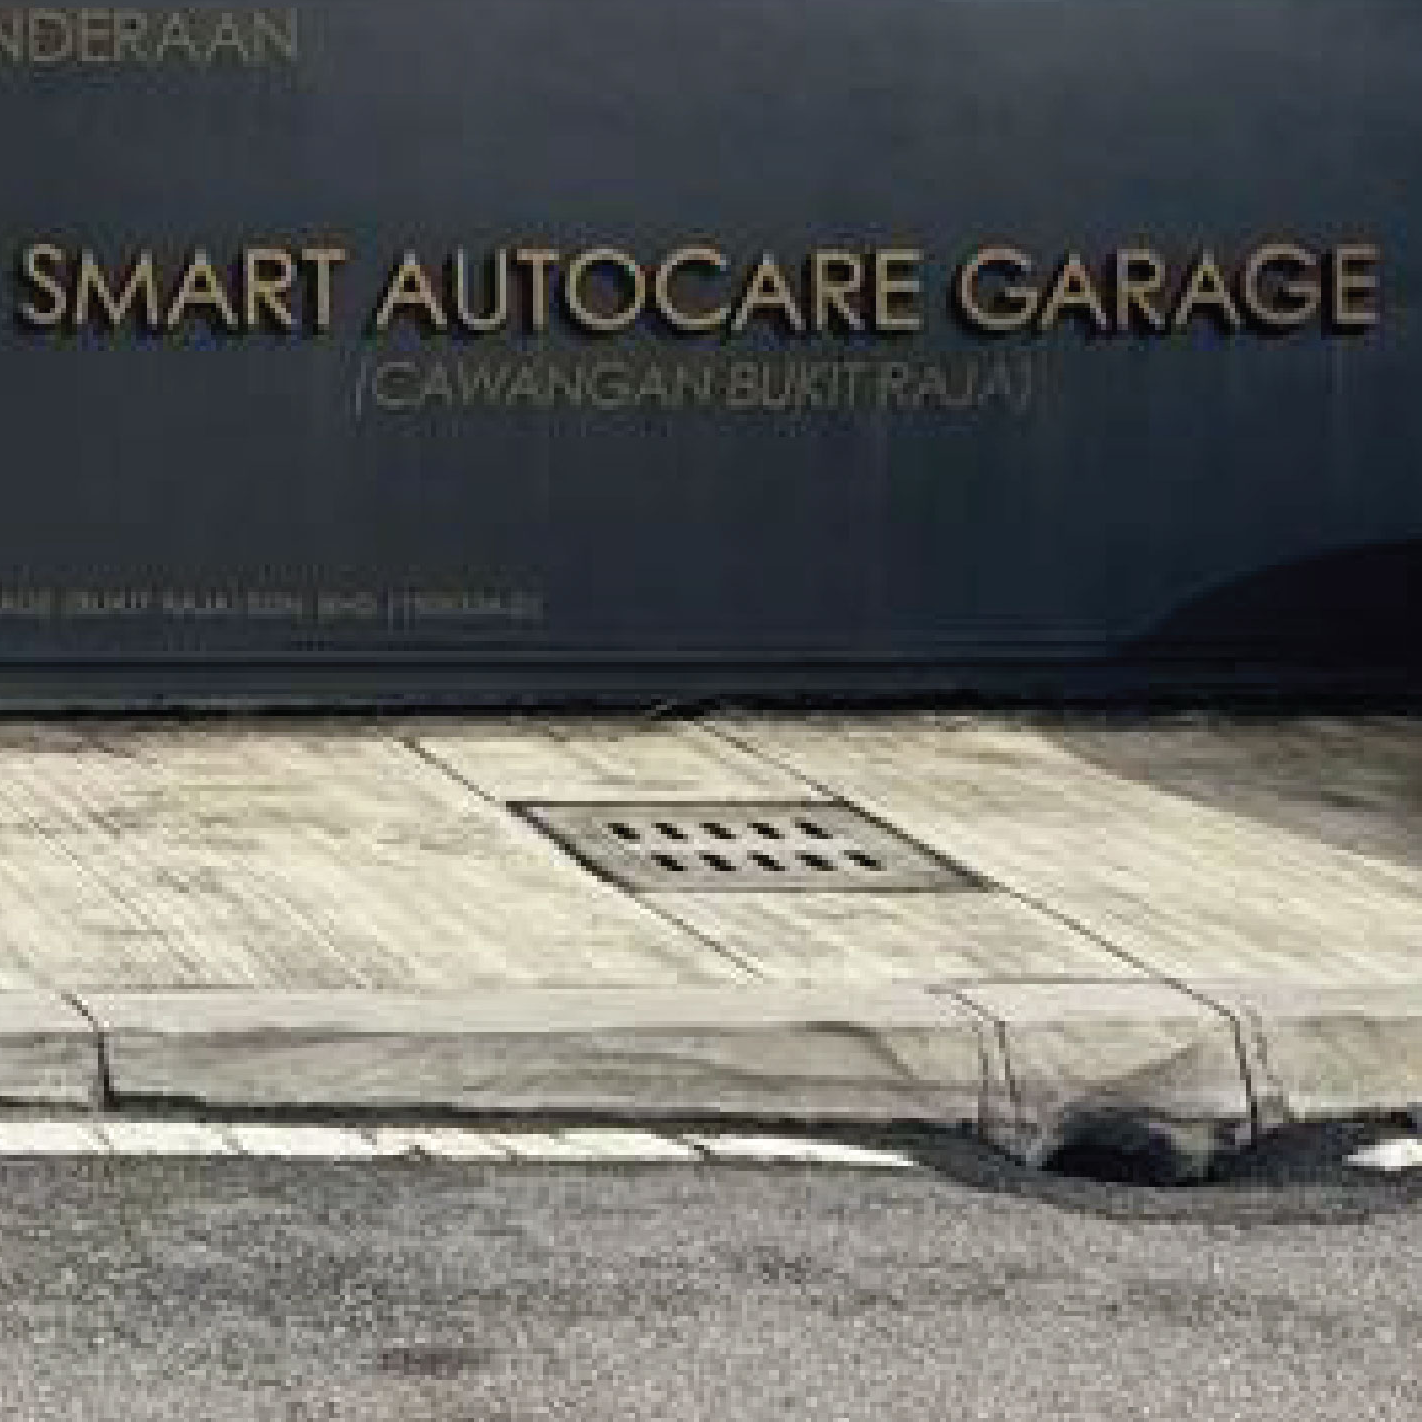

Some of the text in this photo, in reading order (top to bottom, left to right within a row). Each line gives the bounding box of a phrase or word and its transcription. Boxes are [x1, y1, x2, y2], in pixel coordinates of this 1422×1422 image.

[21, 242, 1381, 332] SMART AUTOCARE GARAGE
[725, 361, 863, 411] BUKIT
